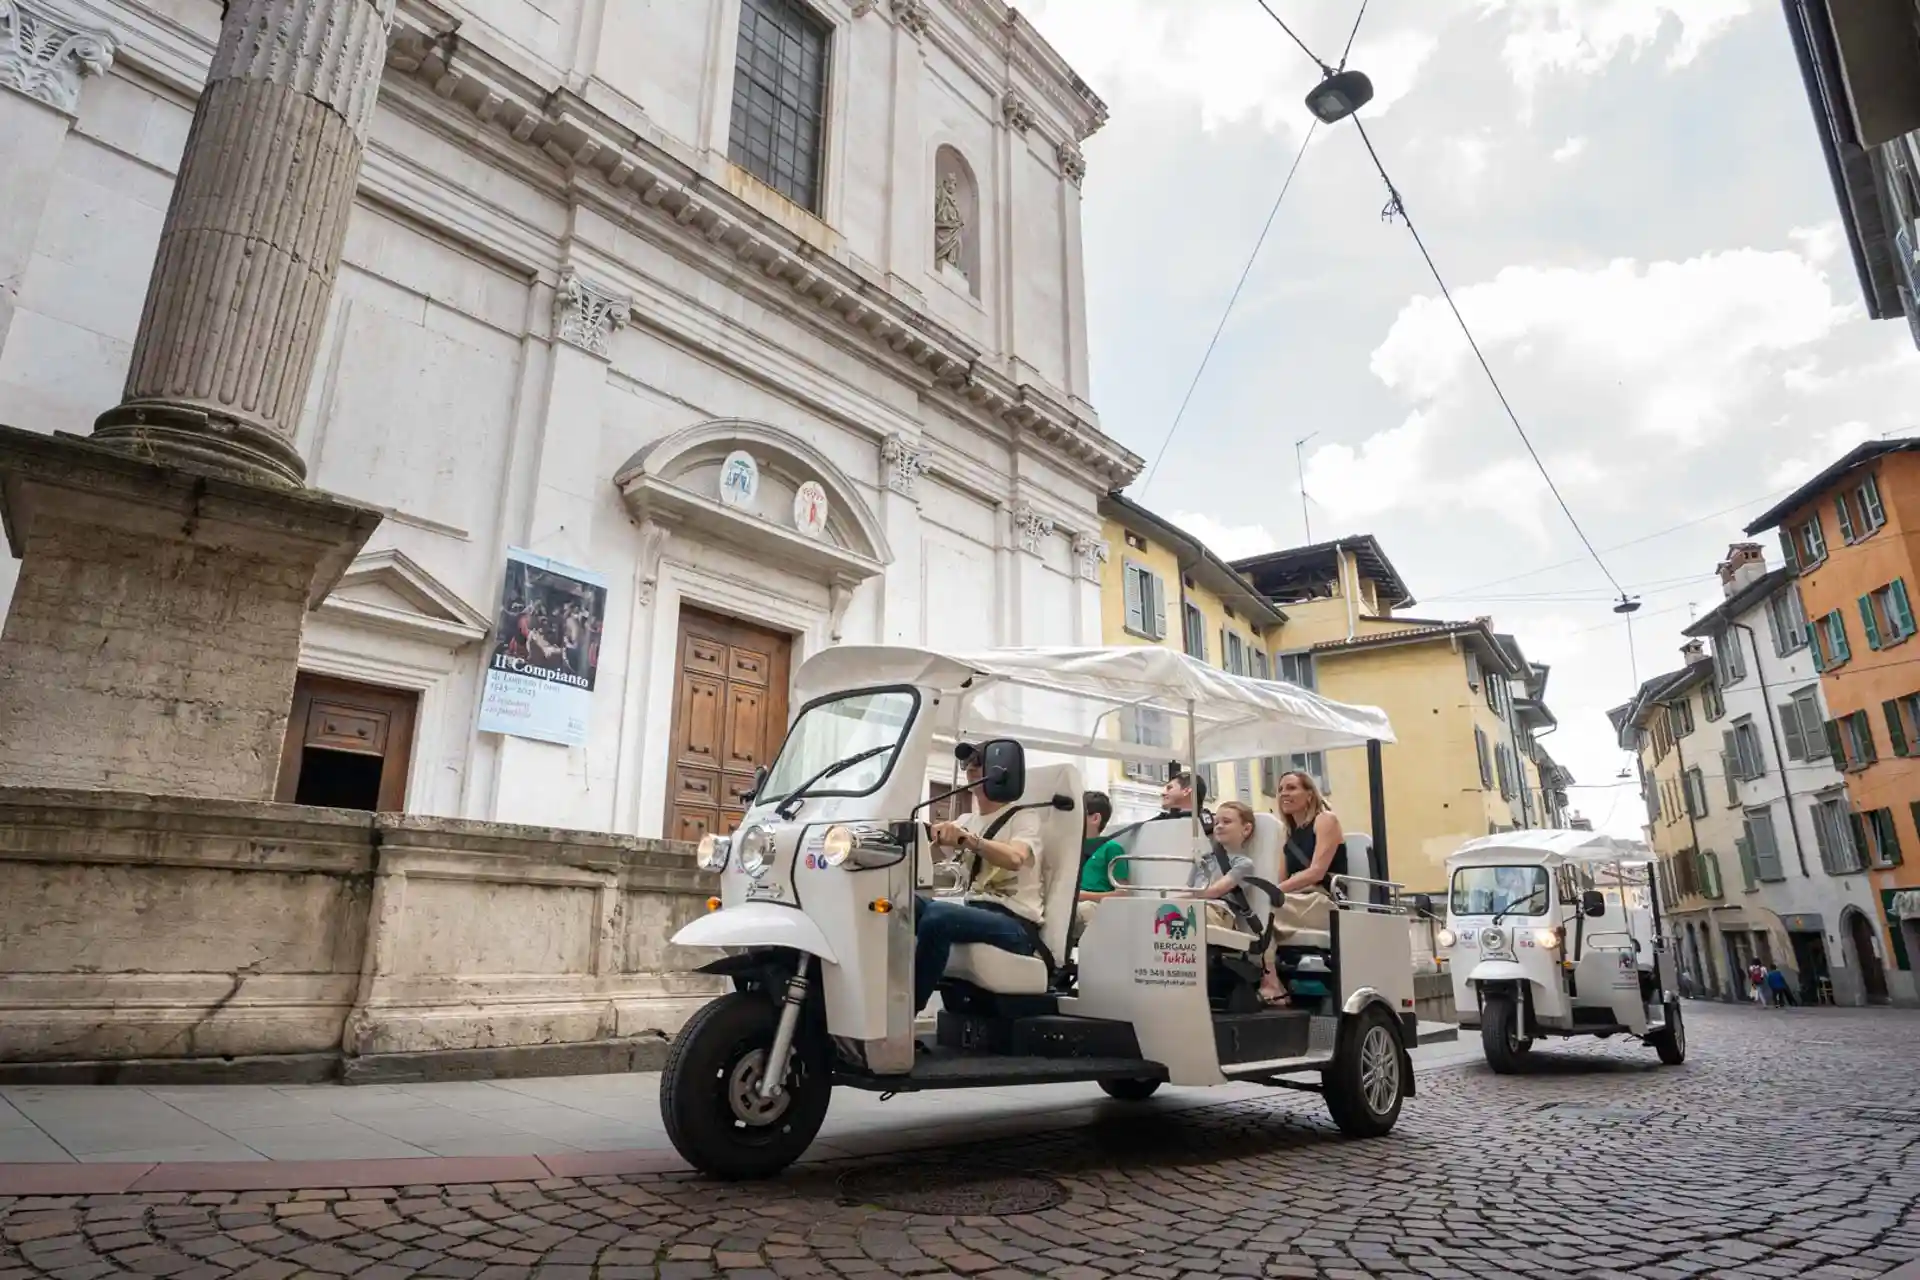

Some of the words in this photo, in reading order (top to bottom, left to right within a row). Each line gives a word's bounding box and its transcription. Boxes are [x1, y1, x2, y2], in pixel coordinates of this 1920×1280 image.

[495, 653, 508, 669] Il
[511, 656, 589, 688] Compianto
[1153, 942, 1197, 951] BERGAMO
[1162, 952, 1197, 964] TukTuk
